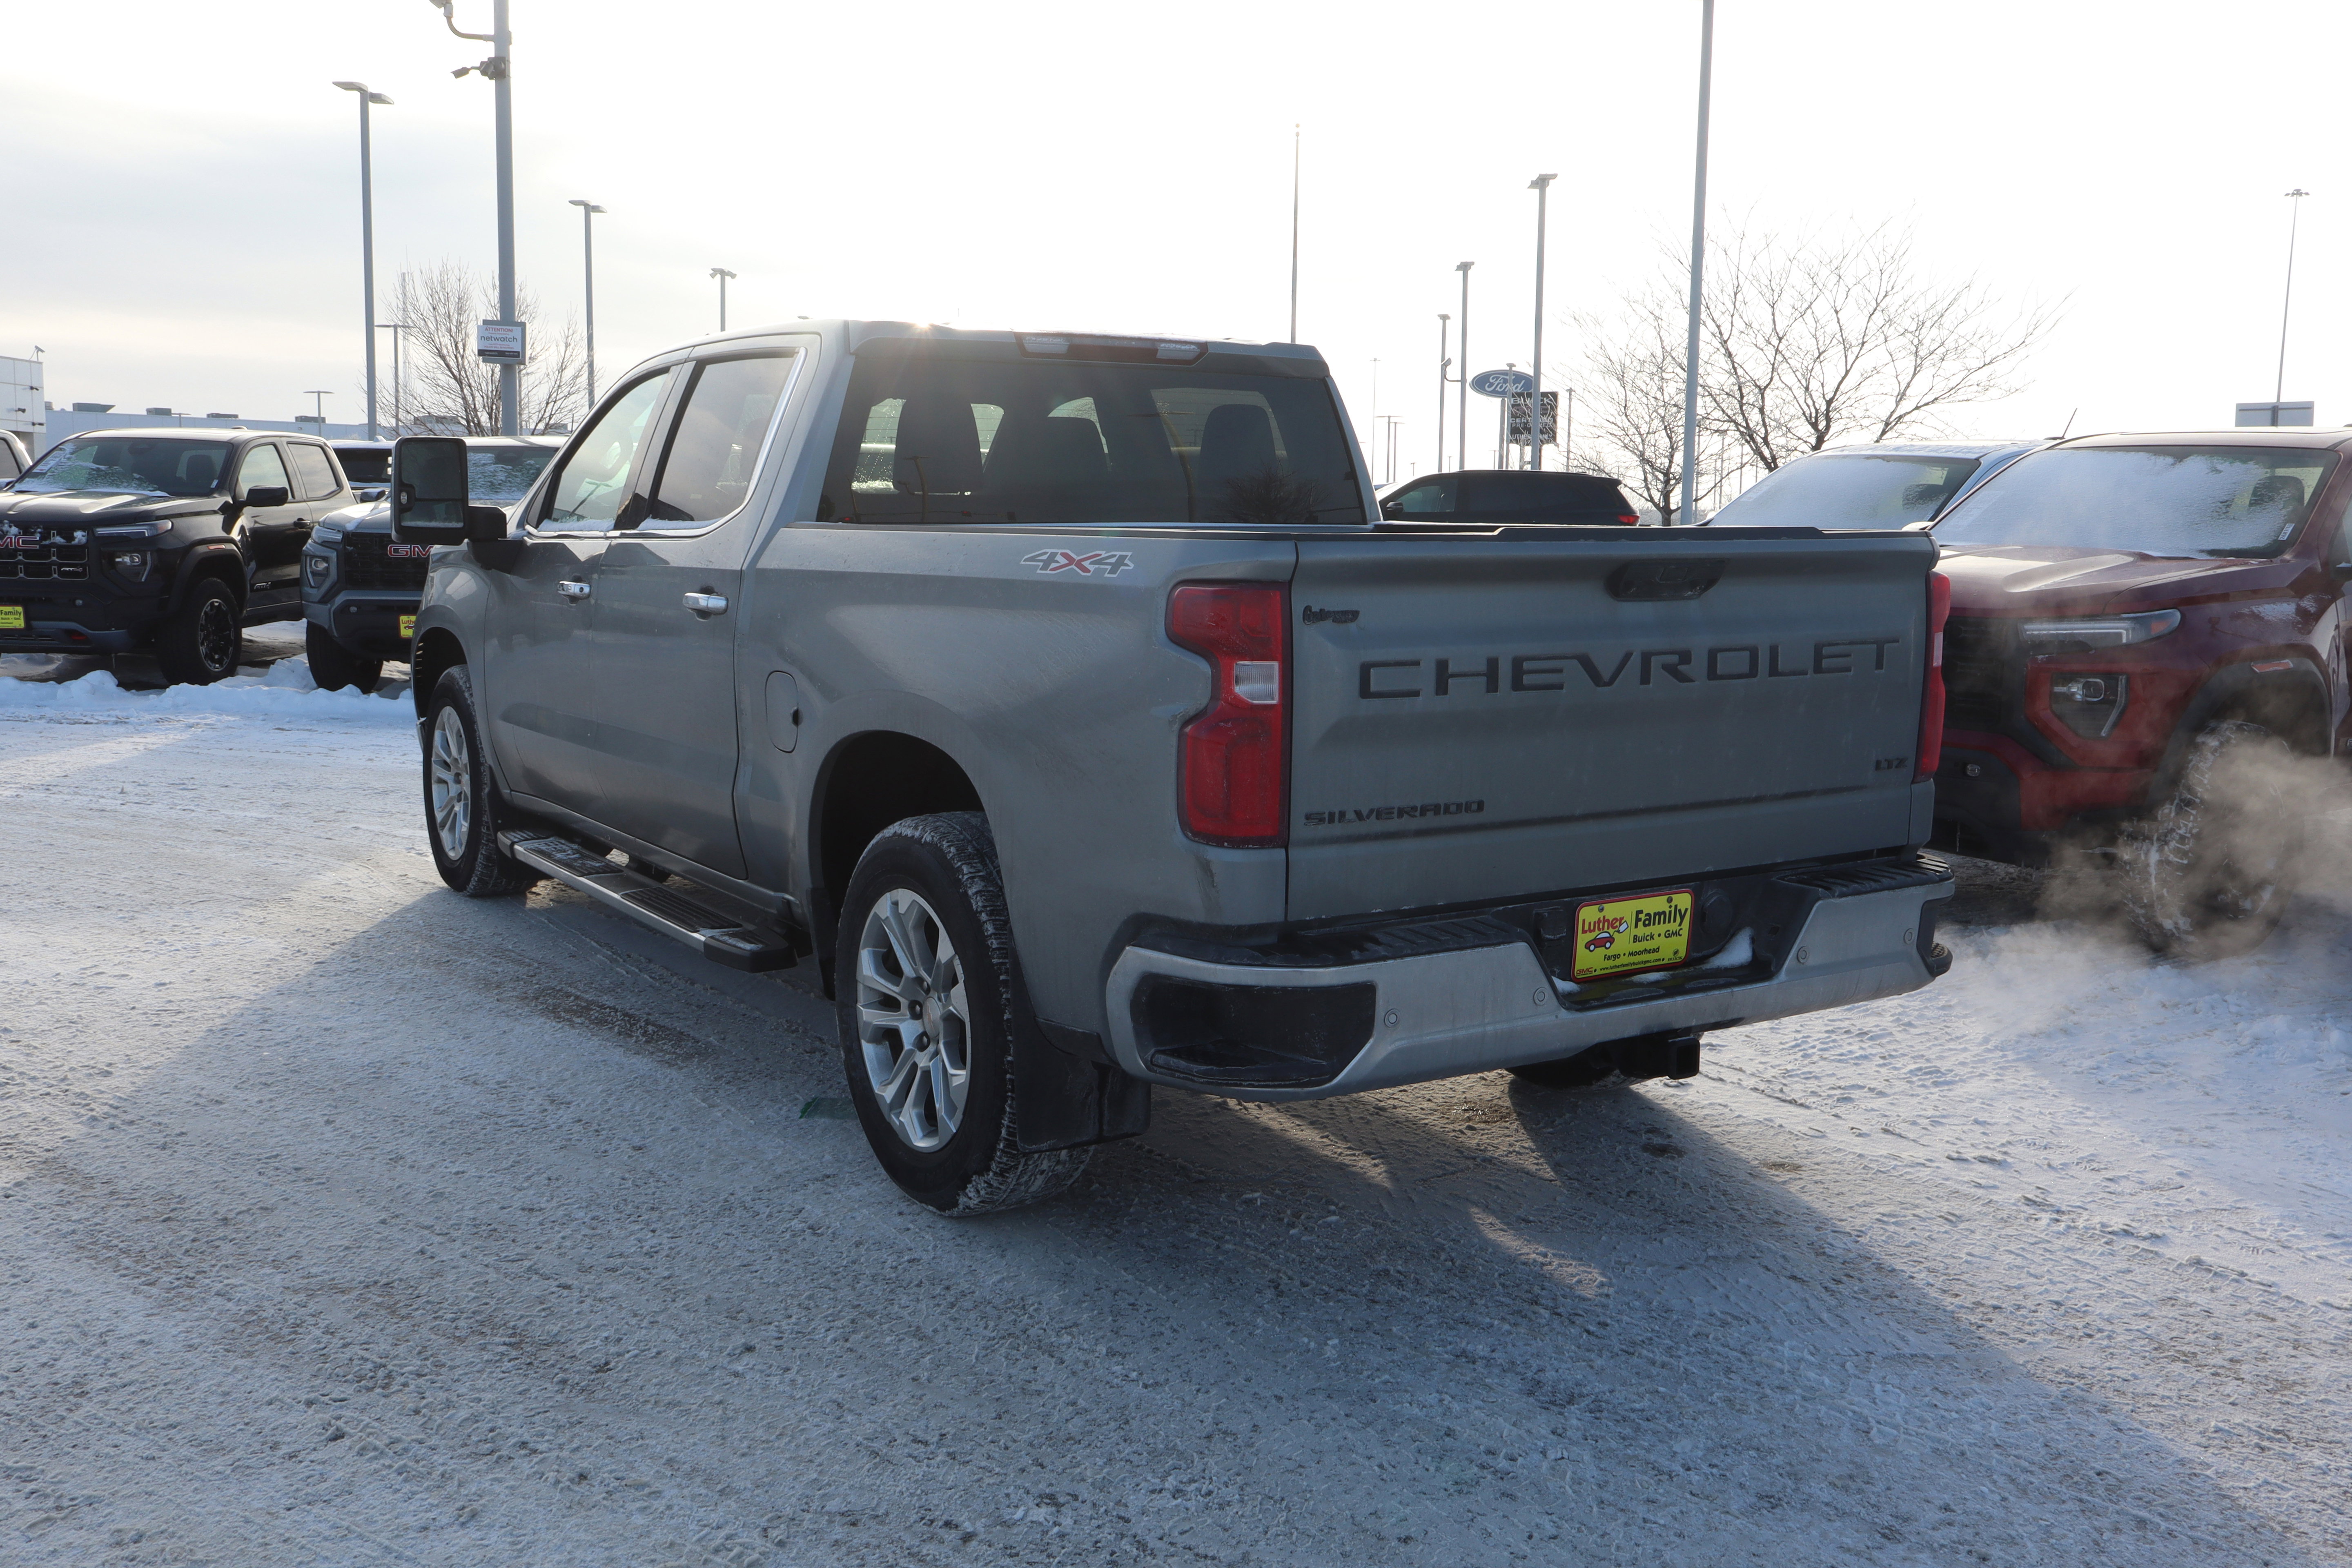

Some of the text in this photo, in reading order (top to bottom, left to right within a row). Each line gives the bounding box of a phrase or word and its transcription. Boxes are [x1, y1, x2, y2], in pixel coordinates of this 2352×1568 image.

[0, 536, 39, 549] MC
[388, 544, 434, 557] GM
[1360, 638, 1900, 699] CHEVROLET
[1875, 758, 1908, 771] LTZ
[1304, 799, 1485, 826] SILVERADO
[1581, 904, 1688, 934] Luther Family
[1633, 928, 1683, 944] Buick GMC
[1628, 946, 1660, 957] Moorhead
[1600, 958, 1661, 971] www.lutherfamilybuickgmc.com
